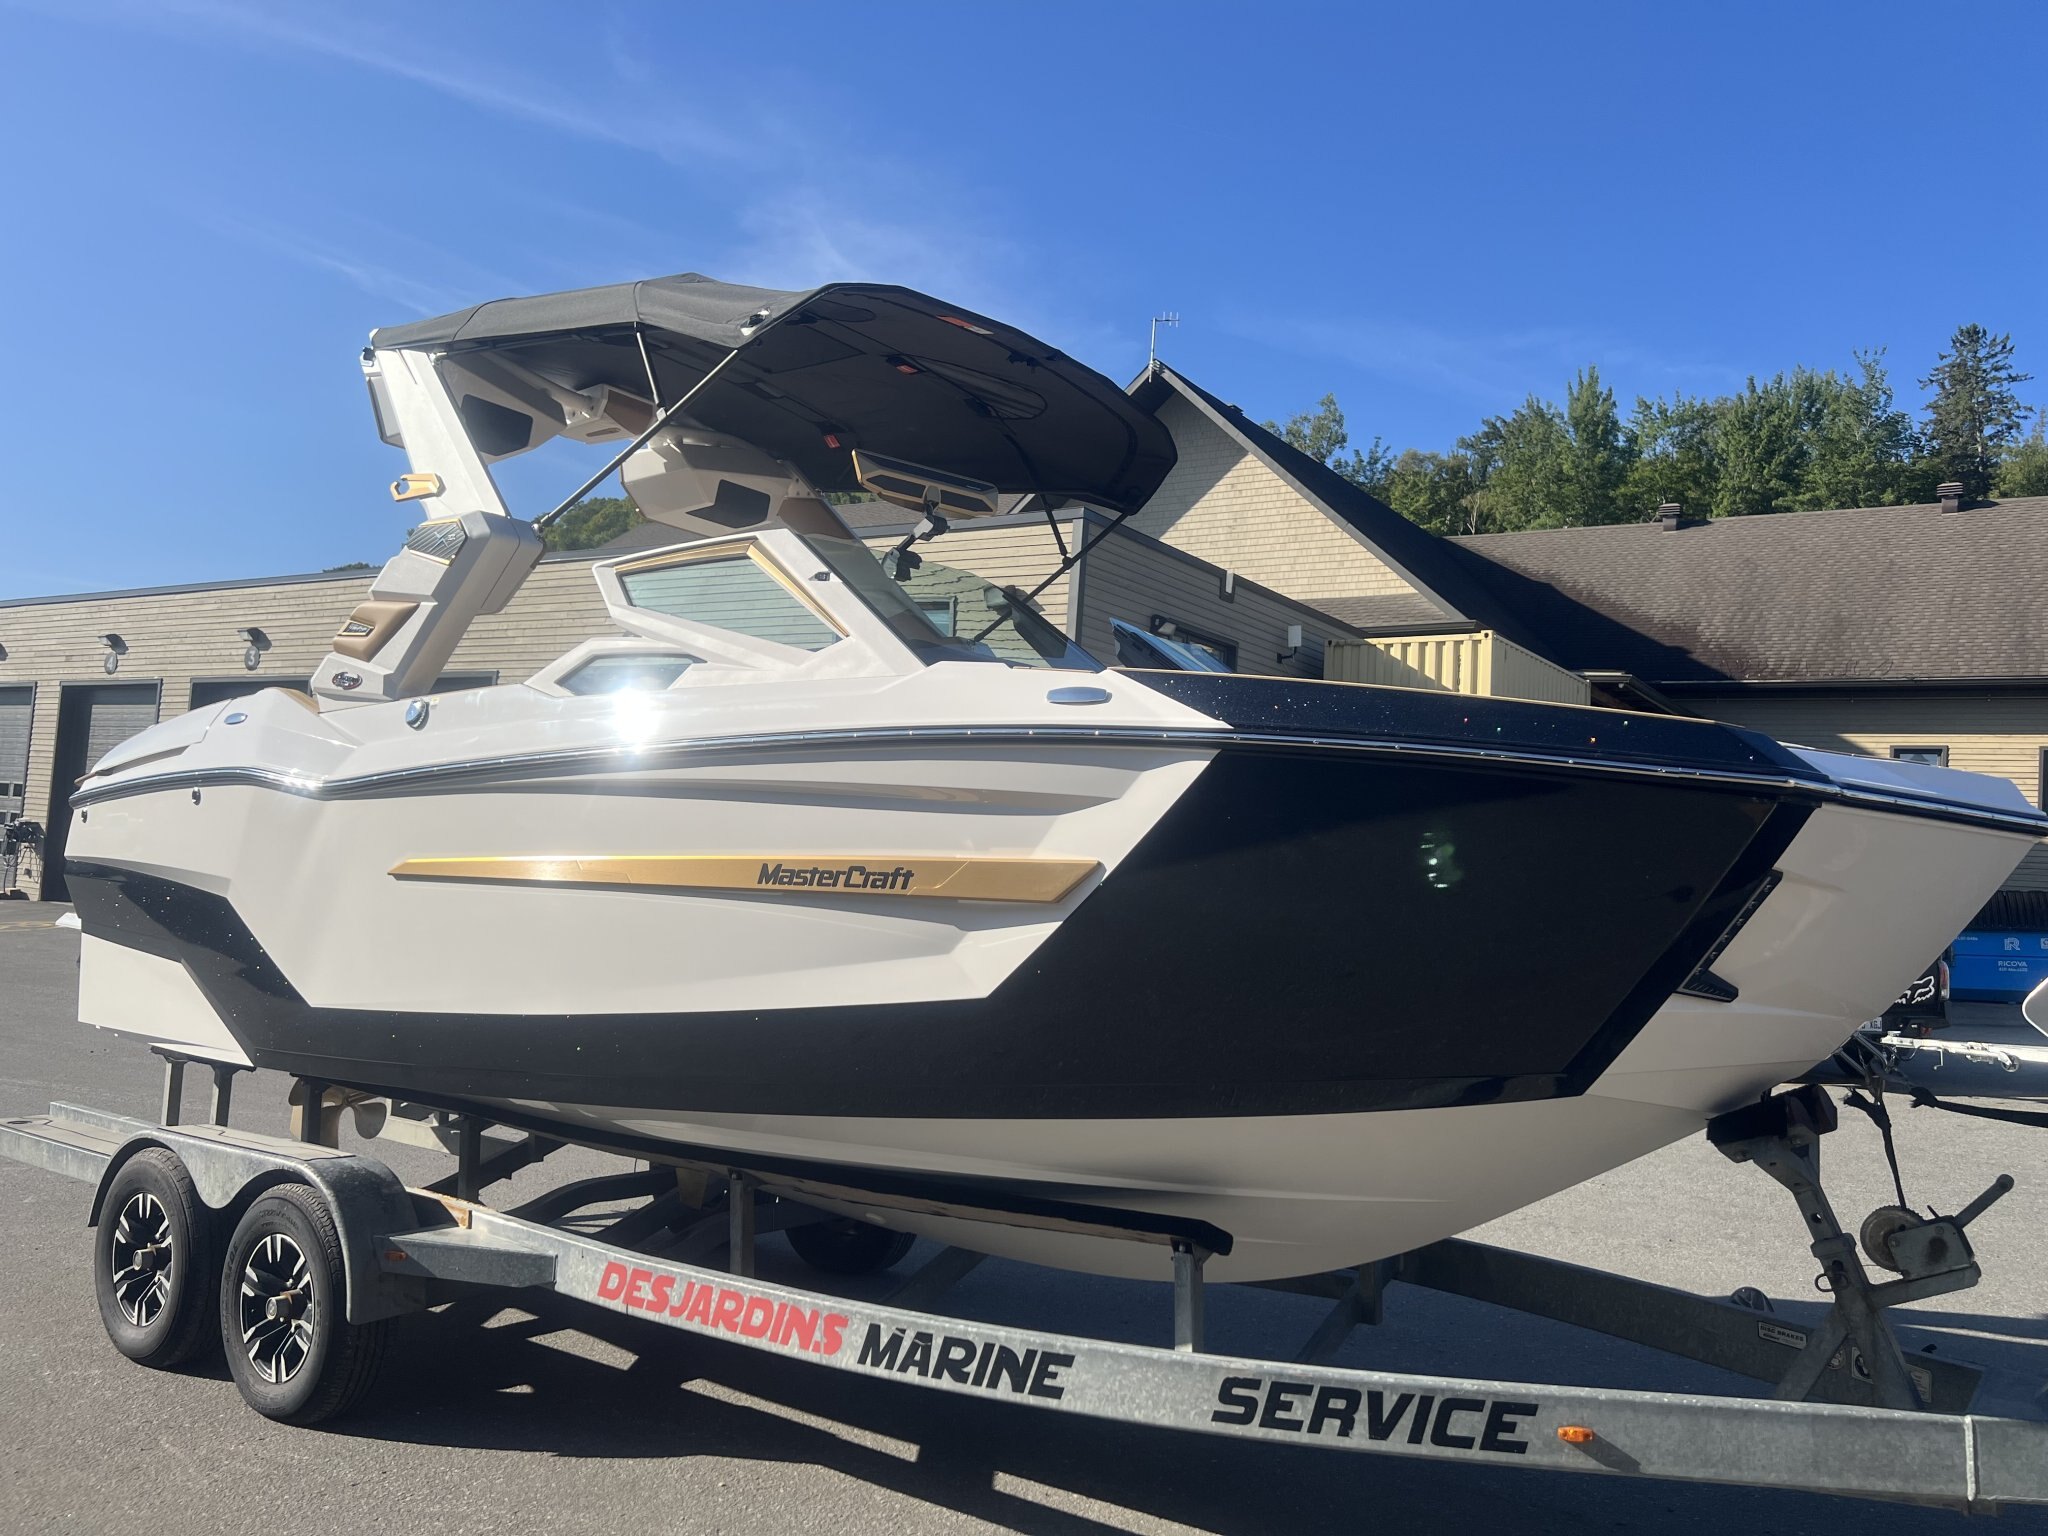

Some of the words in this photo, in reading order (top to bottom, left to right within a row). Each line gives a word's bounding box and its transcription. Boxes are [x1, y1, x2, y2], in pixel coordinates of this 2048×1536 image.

[107, 656, 114, 670] 4
[248, 652, 255, 666] 3
[757, 863, 914, 890] MasterCraft
[1777, 1330, 1804, 1342] BRAKES
[597, 1261, 849, 1355] DESJARDINS
[857, 1322, 1075, 1400] MARINE
[1211, 1376, 1539, 1454] SERVICE
